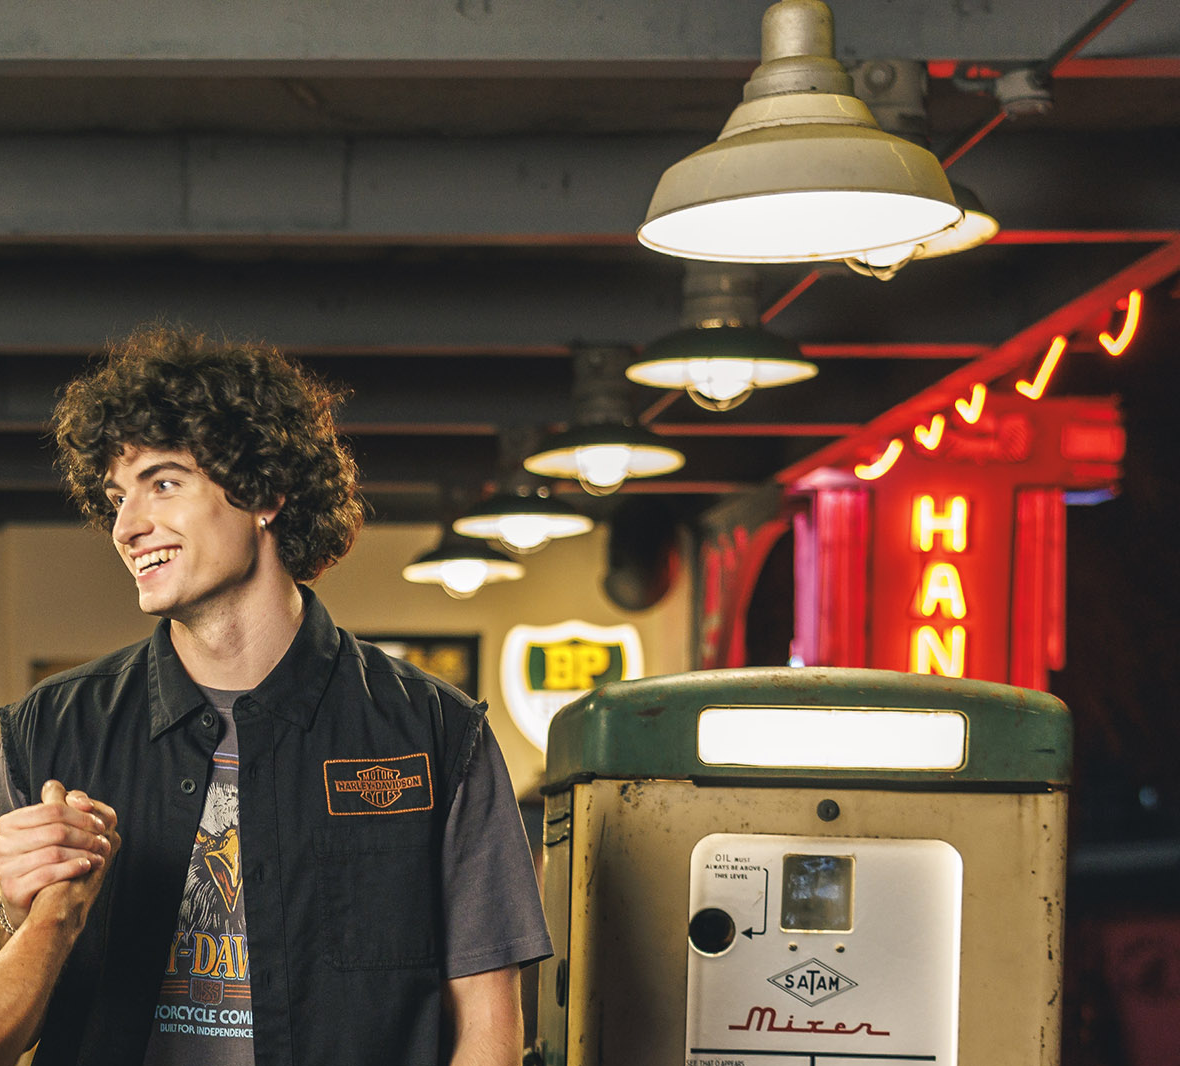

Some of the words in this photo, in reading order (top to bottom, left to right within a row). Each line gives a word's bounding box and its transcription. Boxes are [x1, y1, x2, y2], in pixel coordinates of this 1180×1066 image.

[542, 643, 610, 690] BP
[362, 769, 395, 781] MOTOR
[337, 775, 421, 791] HARLEY-DAVIDSON
[364, 791, 397, 806] CYCLES
[715, 853, 731, 862] OIL
[785, 970, 840, 995] SATAM
[729, 1006, 890, 1036] Mixer
[178, 1024, 195, 1034] FOR
[196, 1027, 254, 1038] INDEPENDENCE
